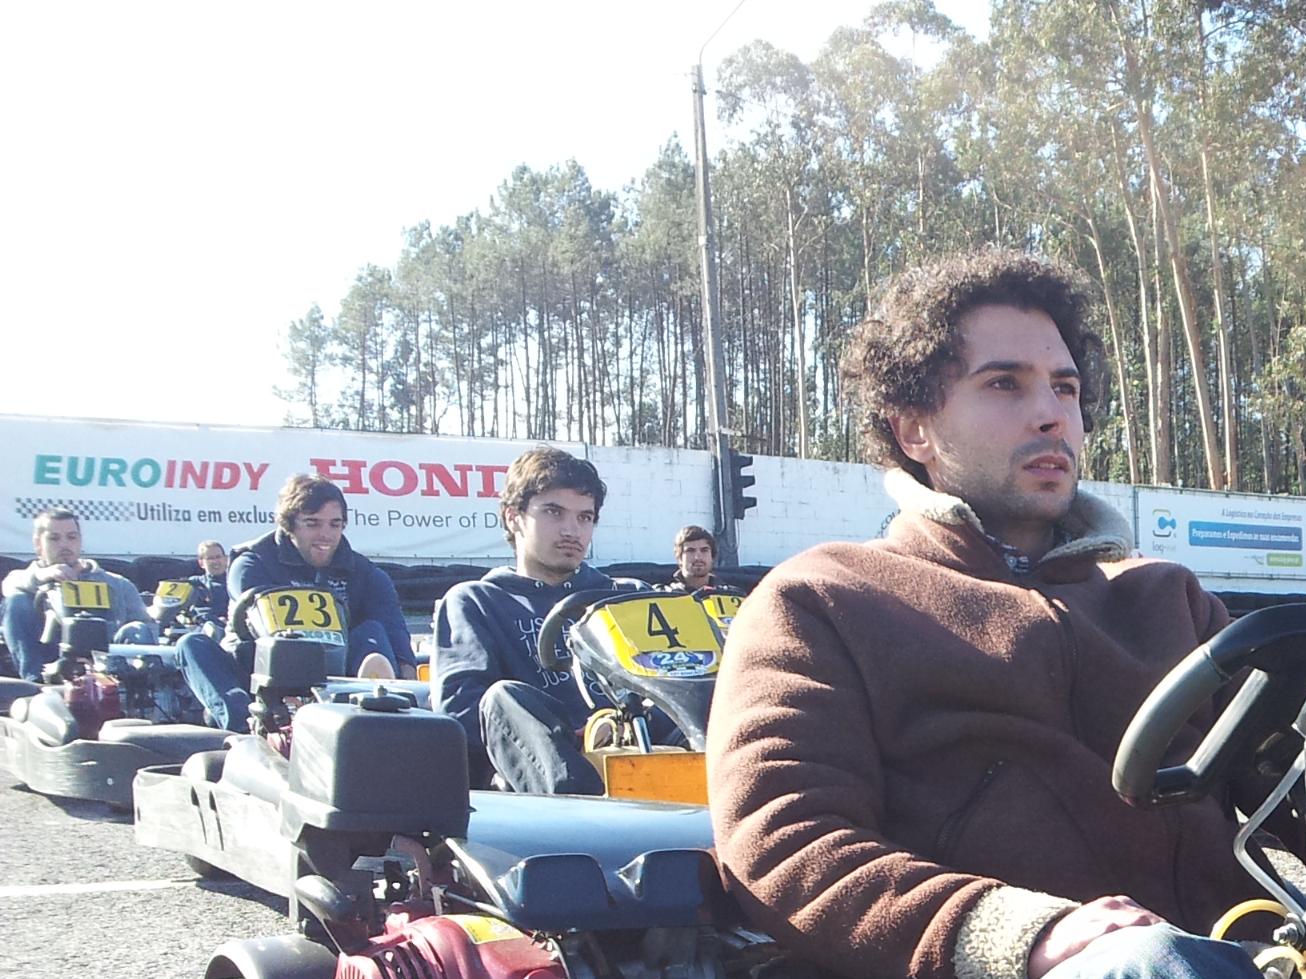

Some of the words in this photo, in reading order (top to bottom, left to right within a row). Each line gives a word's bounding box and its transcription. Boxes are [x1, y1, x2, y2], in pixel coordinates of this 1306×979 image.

[33, 454, 269, 491] EUROINDY
[310, 458, 510, 498] HOND
[136, 502, 192, 522] Utiliza
[198, 510, 222, 523] em
[228, 505, 276, 524] exclus
[346, 508, 379, 527] The
[389, 510, 451, 529] Power
[459, 511, 477, 529] of
[166, 583, 178, 596] 2
[278, 593, 332, 628] 23
[647, 602, 688, 649] 4
[657, 652, 690, 665] 24
